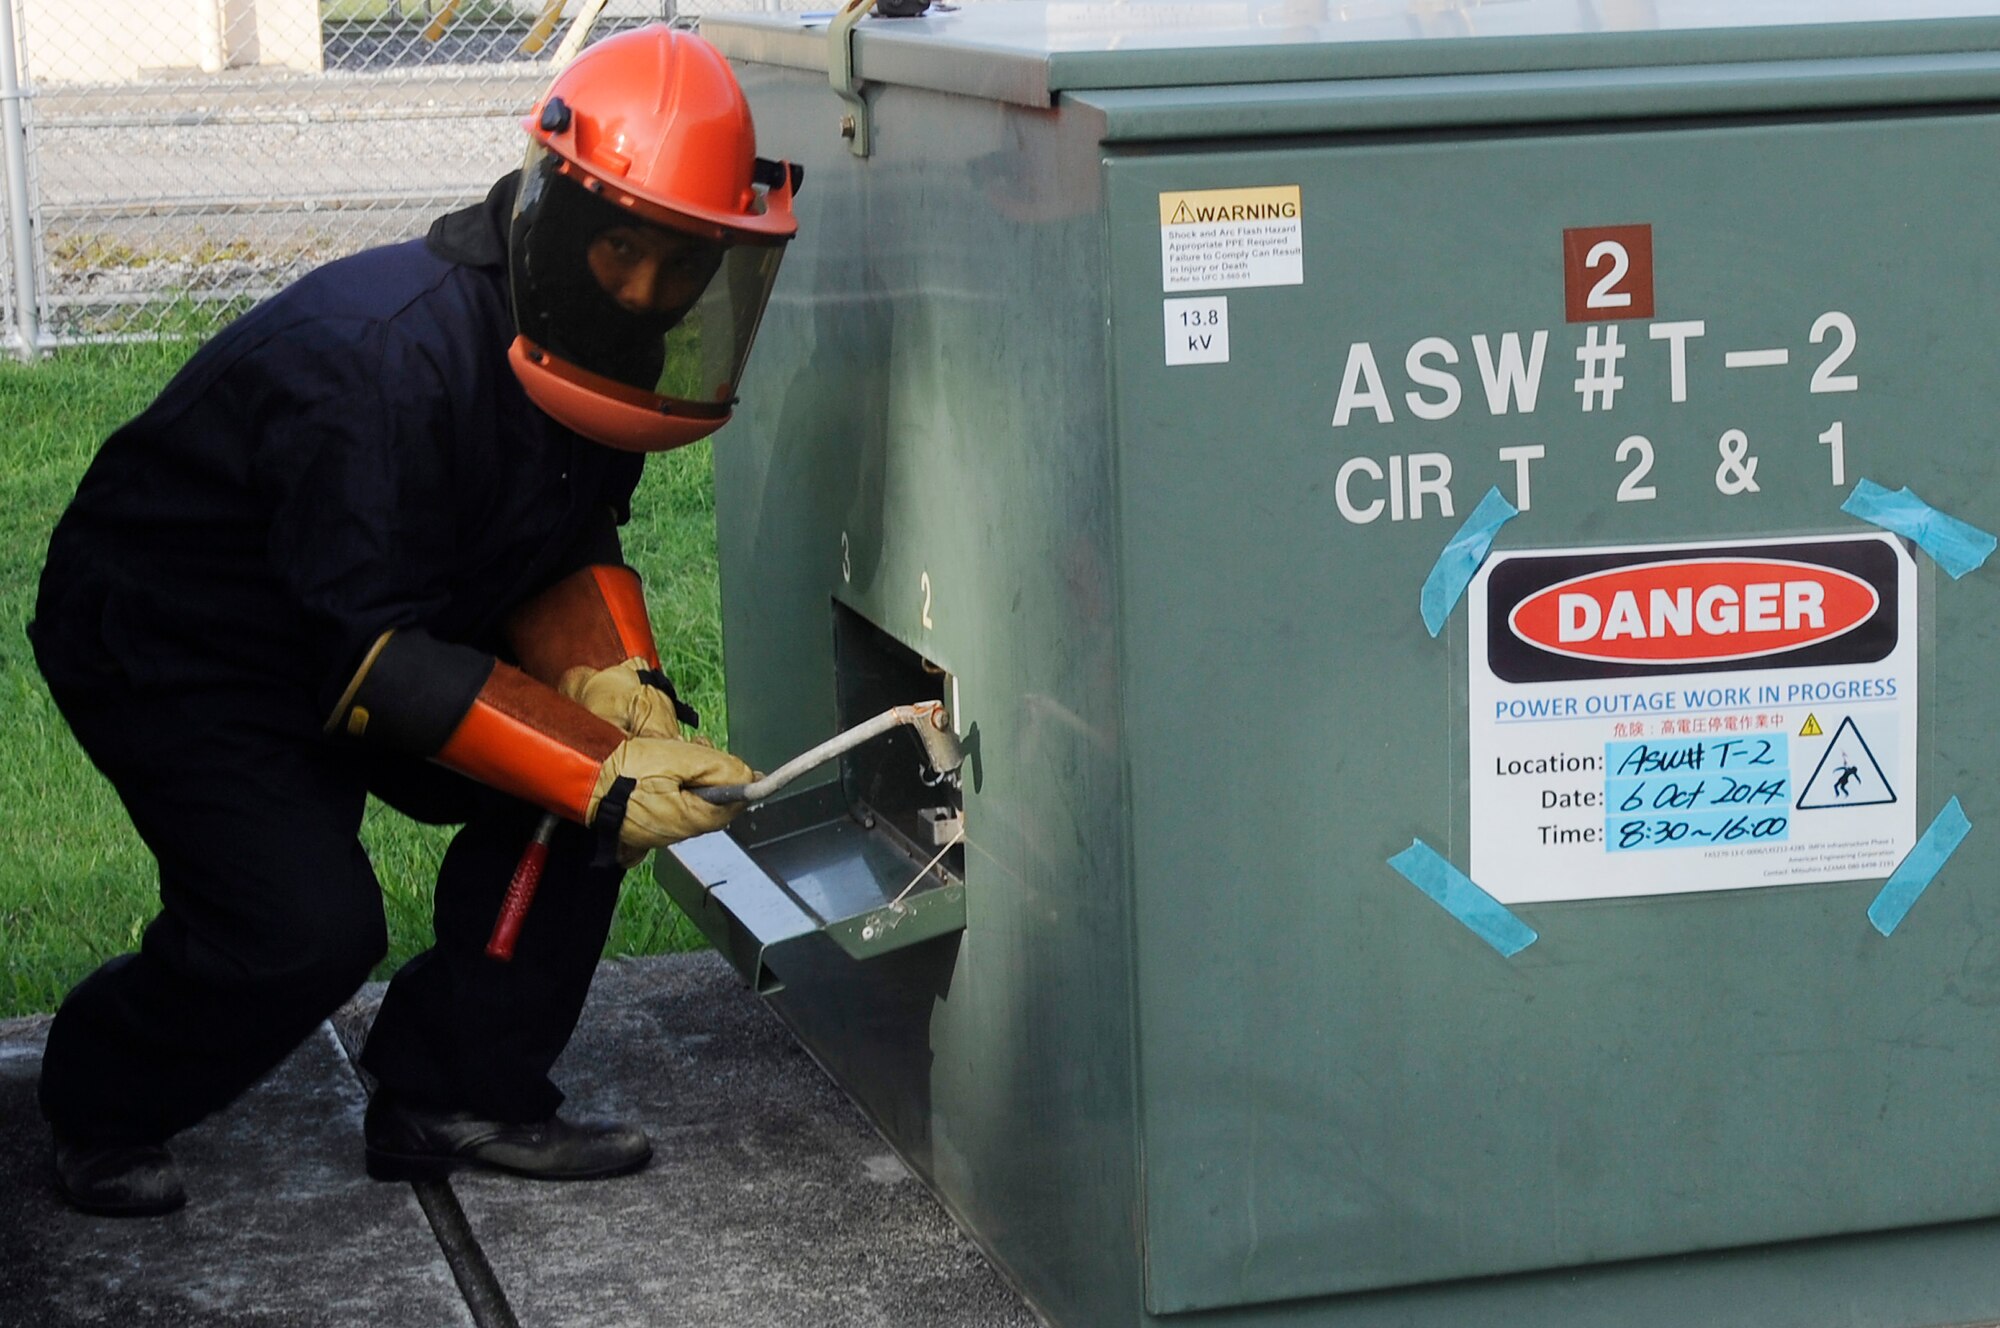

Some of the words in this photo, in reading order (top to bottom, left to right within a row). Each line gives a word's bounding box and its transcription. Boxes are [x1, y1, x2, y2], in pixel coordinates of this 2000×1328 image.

[1196, 202, 1297, 222] WARNING
[1169, 231, 1196, 239] Shock
[1199, 229, 1216, 237] and
[1220, 228, 1234, 237] Arc
[1237, 226, 1263, 235] Flash
[1265, 225, 1297, 234] Hazard
[1169, 241, 1223, 252] Appropriate
[1225, 239, 1246, 248] PPE
[1247, 236, 1288, 247] Required
[1169, 253, 1201, 262] Failure
[1203, 252, 1213, 261] to
[1214, 249, 1249, 260] Comply
[1251, 248, 1271, 258] Can
[1272, 247, 1301, 257] Result
[1181, 262, 1207, 274] Injury
[1209, 263, 1219, 272] or
[1221, 261, 1249, 271] Death
[1585, 240, 1632, 309] 2
[1180, 309, 1219, 327] 13.8
[1188, 334, 1212, 351] kV
[1335, 452, 1455, 525] CIR
[1499, 444, 1546, 511] T
[1615, 435, 1657, 502] 2
[1715, 428, 1761, 496] &
[1818, 421, 1845, 486] 1
[841, 531, 851, 583] 3
[921, 571, 932, 630] 2
[1558, 580, 1826, 644] DANGER
[1496, 697, 1578, 719] POWER
[1585, 691, 1677, 714] OUTAGE
[1683, 687, 1751, 709] WORK
[1759, 685, 1780, 704] IN
[1788, 677, 1897, 701] PROGRESS
[1496, 753, 1604, 776] Location:
[1711, 739, 1776, 768] T-2
[1541, 788, 1604, 810] Date:
[1620, 781, 1646, 812] 6
[1653, 780, 1705, 810] Oct
[1710, 776, 1786, 806] 2014
[1538, 824, 1604, 846] Time:
[1788, 854, 1818, 863] American
[1820, 852, 1856, 861] Engineering
[1857, 850, 1895, 858] Corporation
